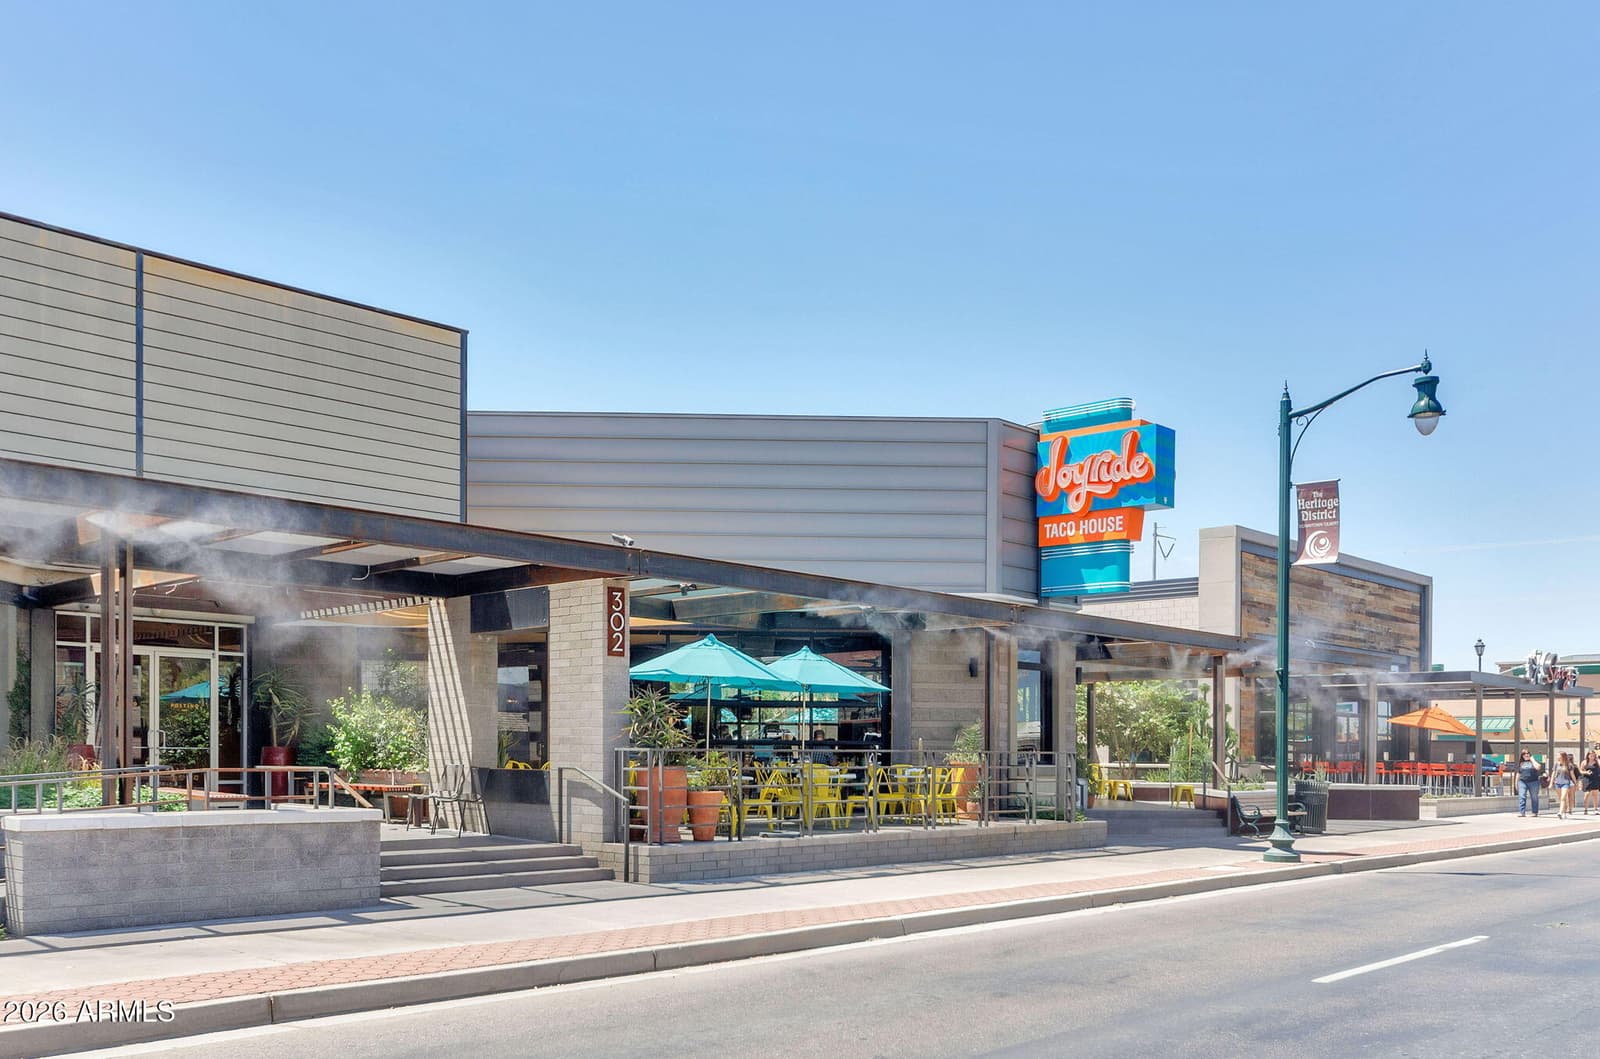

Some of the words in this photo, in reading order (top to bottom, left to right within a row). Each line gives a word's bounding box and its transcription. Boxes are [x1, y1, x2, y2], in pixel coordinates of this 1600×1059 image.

[1035, 429, 1154, 515] Joyride
[1298, 498, 1338, 510] Heritage
[1301, 509, 1336, 521] District
[1044, 520, 1076, 539] TACO
[1079, 515, 1124, 535] HOUSE
[610, 592, 624, 652] 302
